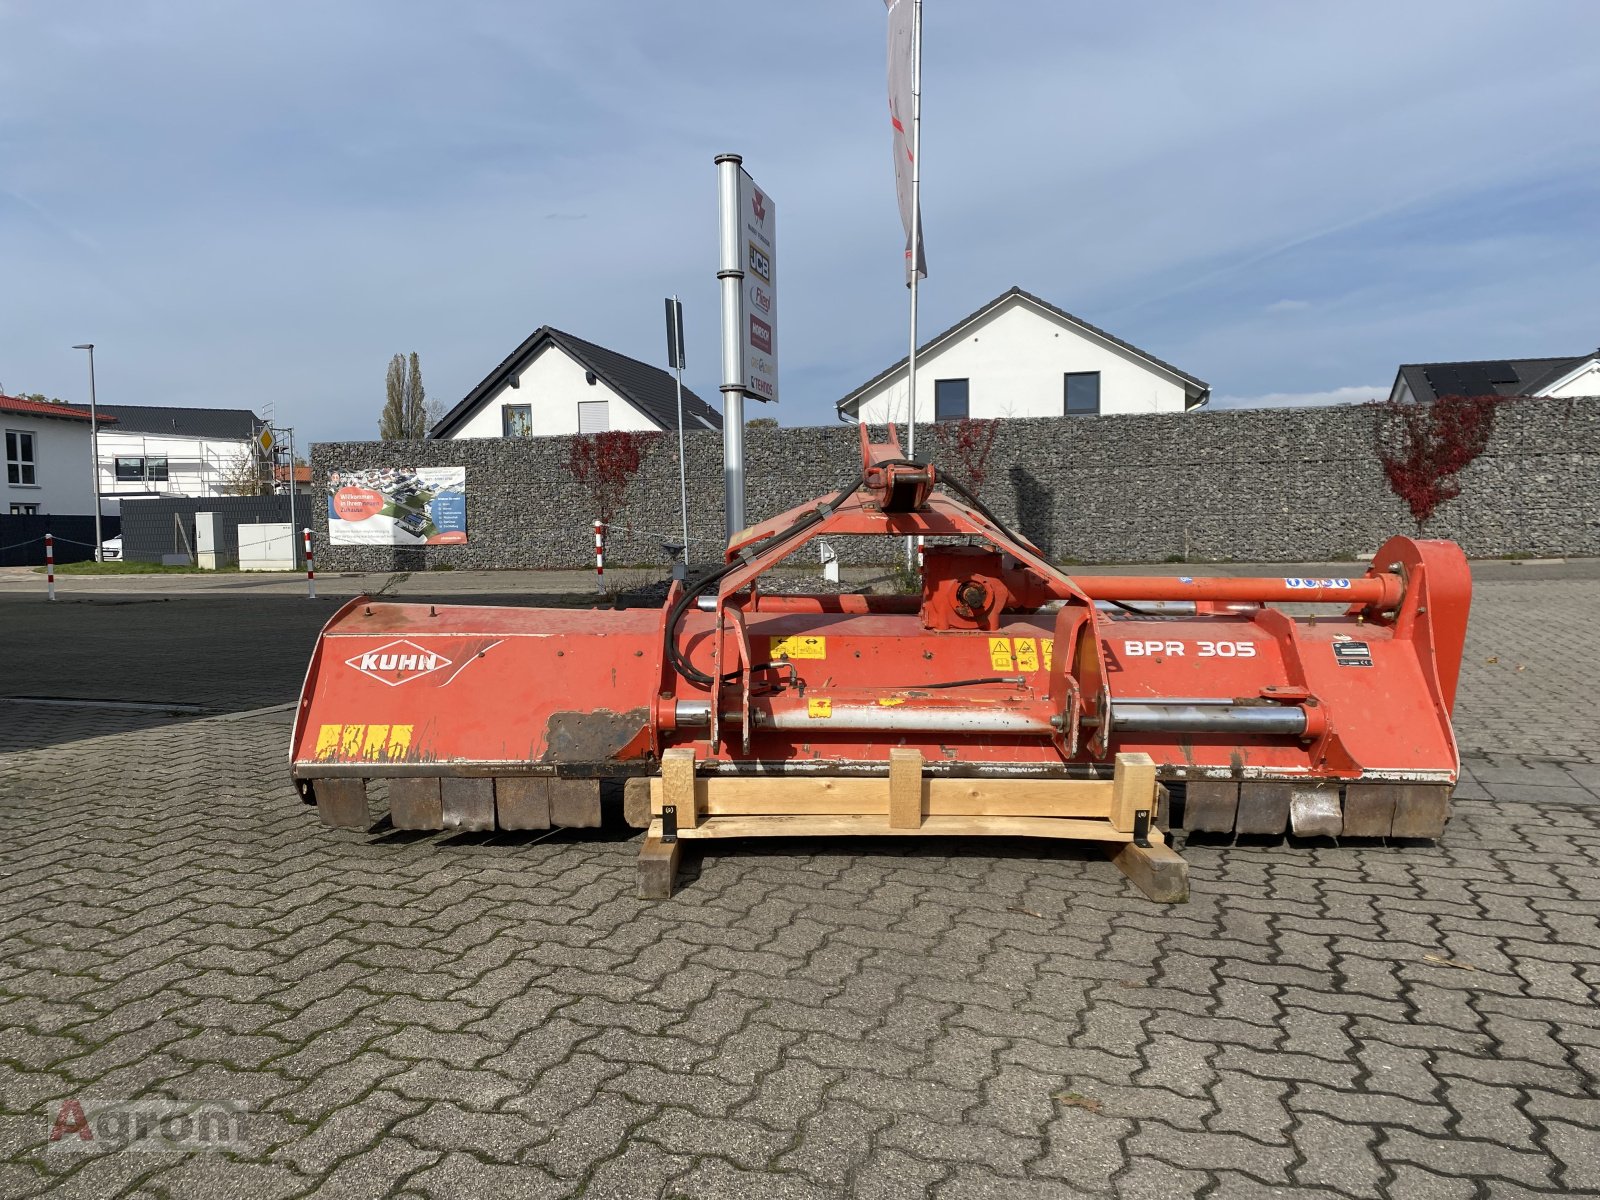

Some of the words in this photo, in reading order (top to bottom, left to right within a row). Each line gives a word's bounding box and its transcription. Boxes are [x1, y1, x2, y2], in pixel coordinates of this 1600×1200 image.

[750, 248, 769, 279] JCB
[752, 322, 770, 341] HORSCH
[1124, 640, 1185, 656] BPR
[1196, 641, 1256, 657] 305
[360, 654, 437, 671] KUHN
